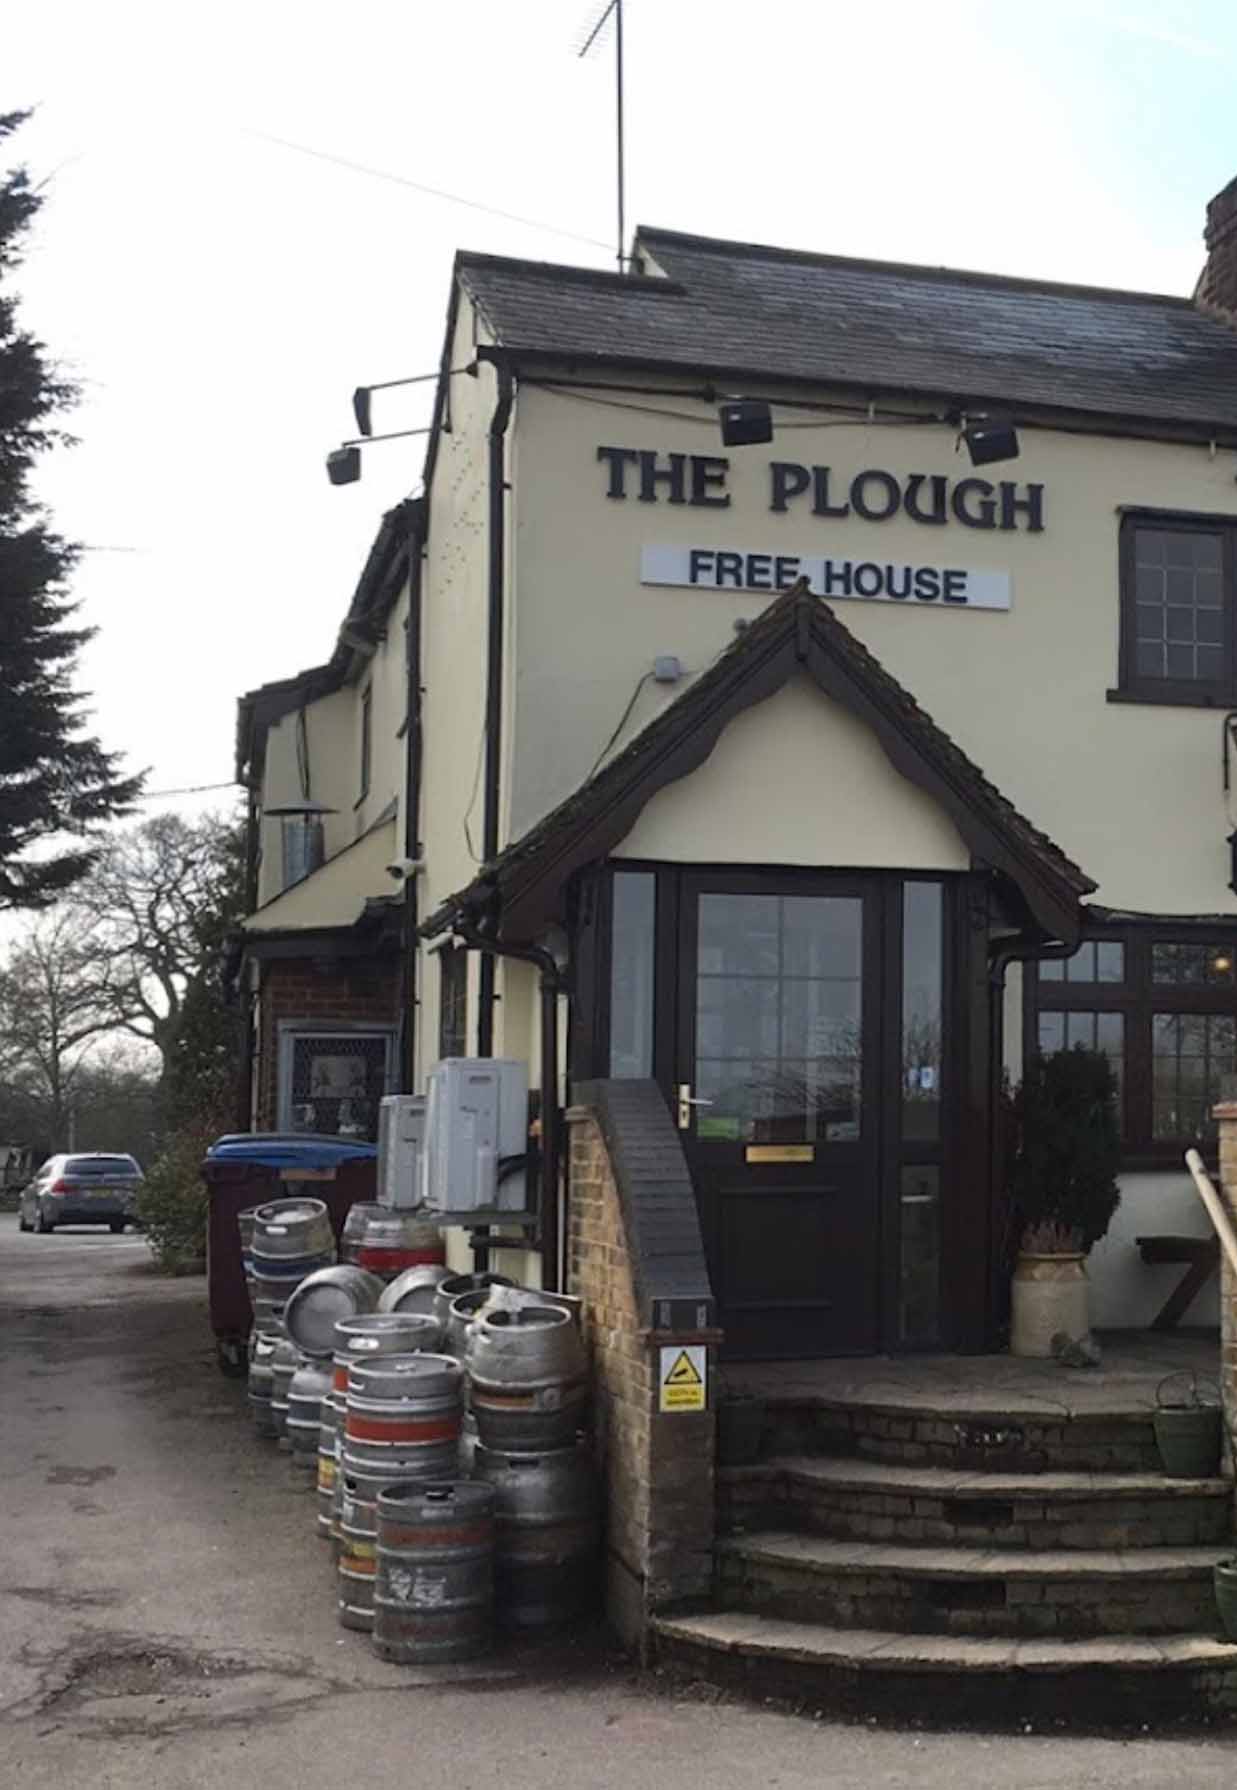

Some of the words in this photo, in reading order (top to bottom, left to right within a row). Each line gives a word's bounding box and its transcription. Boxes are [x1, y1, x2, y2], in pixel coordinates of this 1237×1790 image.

[597, 446, 731, 508] THE
[769, 461, 1044, 532] PLOUGH
[689, 549, 800, 589] FREE
[824, 560, 968, 603] HOUSE
